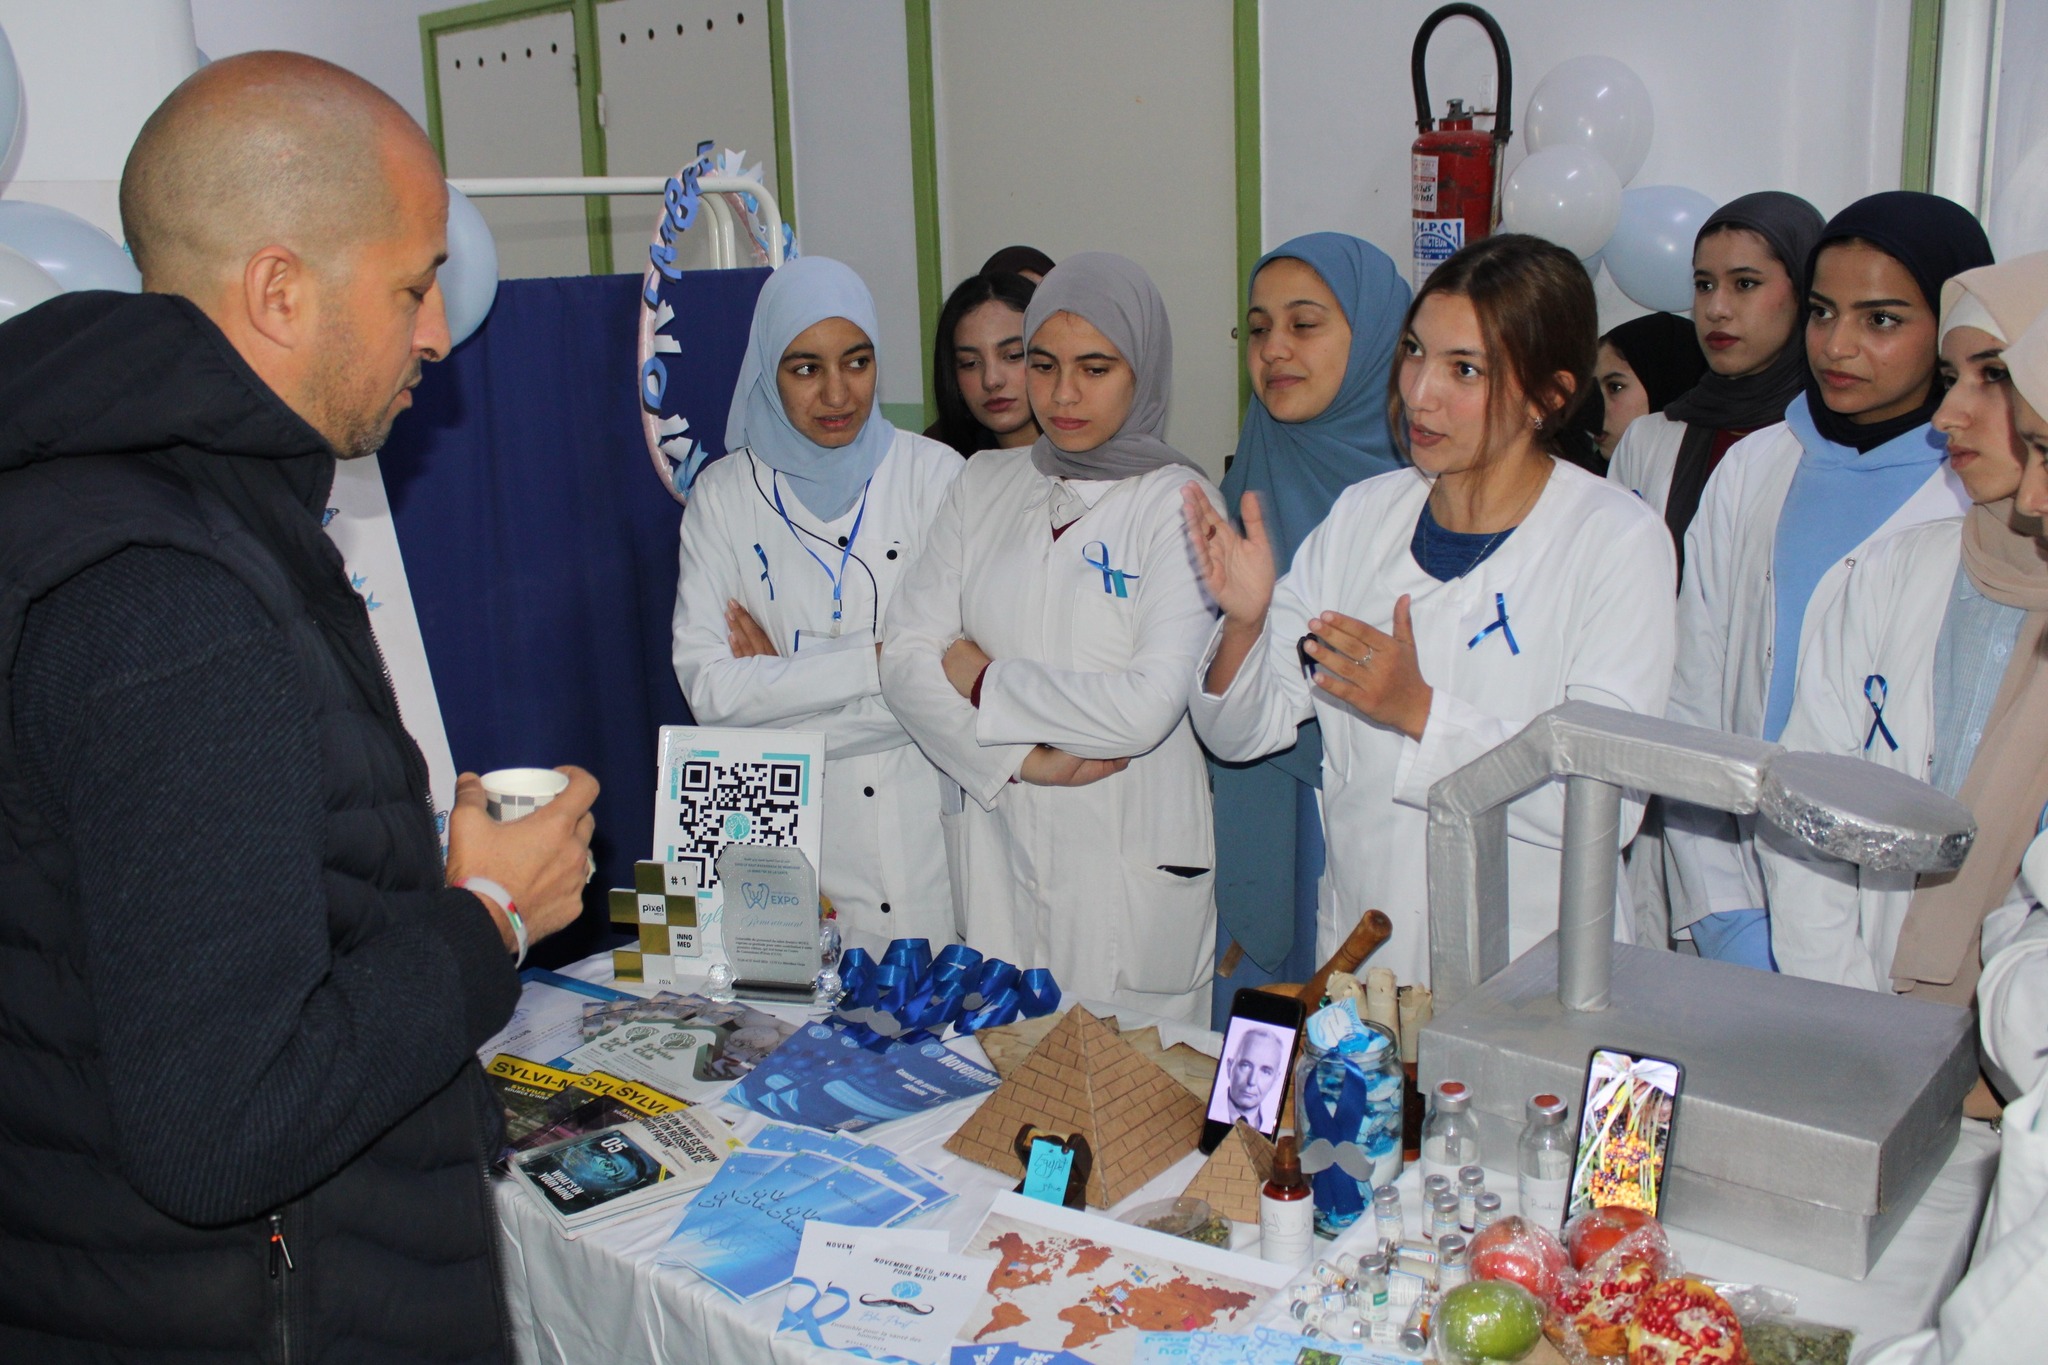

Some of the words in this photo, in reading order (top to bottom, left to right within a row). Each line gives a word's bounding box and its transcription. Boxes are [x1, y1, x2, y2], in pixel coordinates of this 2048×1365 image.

[642, 903, 664, 913] pixel
[771, 895, 800, 906] EXPO
[676, 933, 693, 941] INNO
[937, 1053, 1003, 1087] Novembre
[676, 1125, 697, 1139] AIME
[689, 1138, 704, 1146] CE
[601, 1137, 629, 1154] 05
[690, 1155, 706, 1164] DE
[538, 1172, 557, 1189] YOUR
[552, 1184, 576, 1201] MIND
[551, 1169, 576, 1190] WHAT'S
[572, 1185, 585, 1196] IN
[826, 1241, 856, 1250] NOVEM
[873, 1257, 914, 1270] NOVEMBRE
[939, 1270, 951, 1278] UN
[952, 1273, 968, 1282] PAS
[892, 1268, 913, 1277] POUR
[914, 1273, 938, 1282] MIEUX
